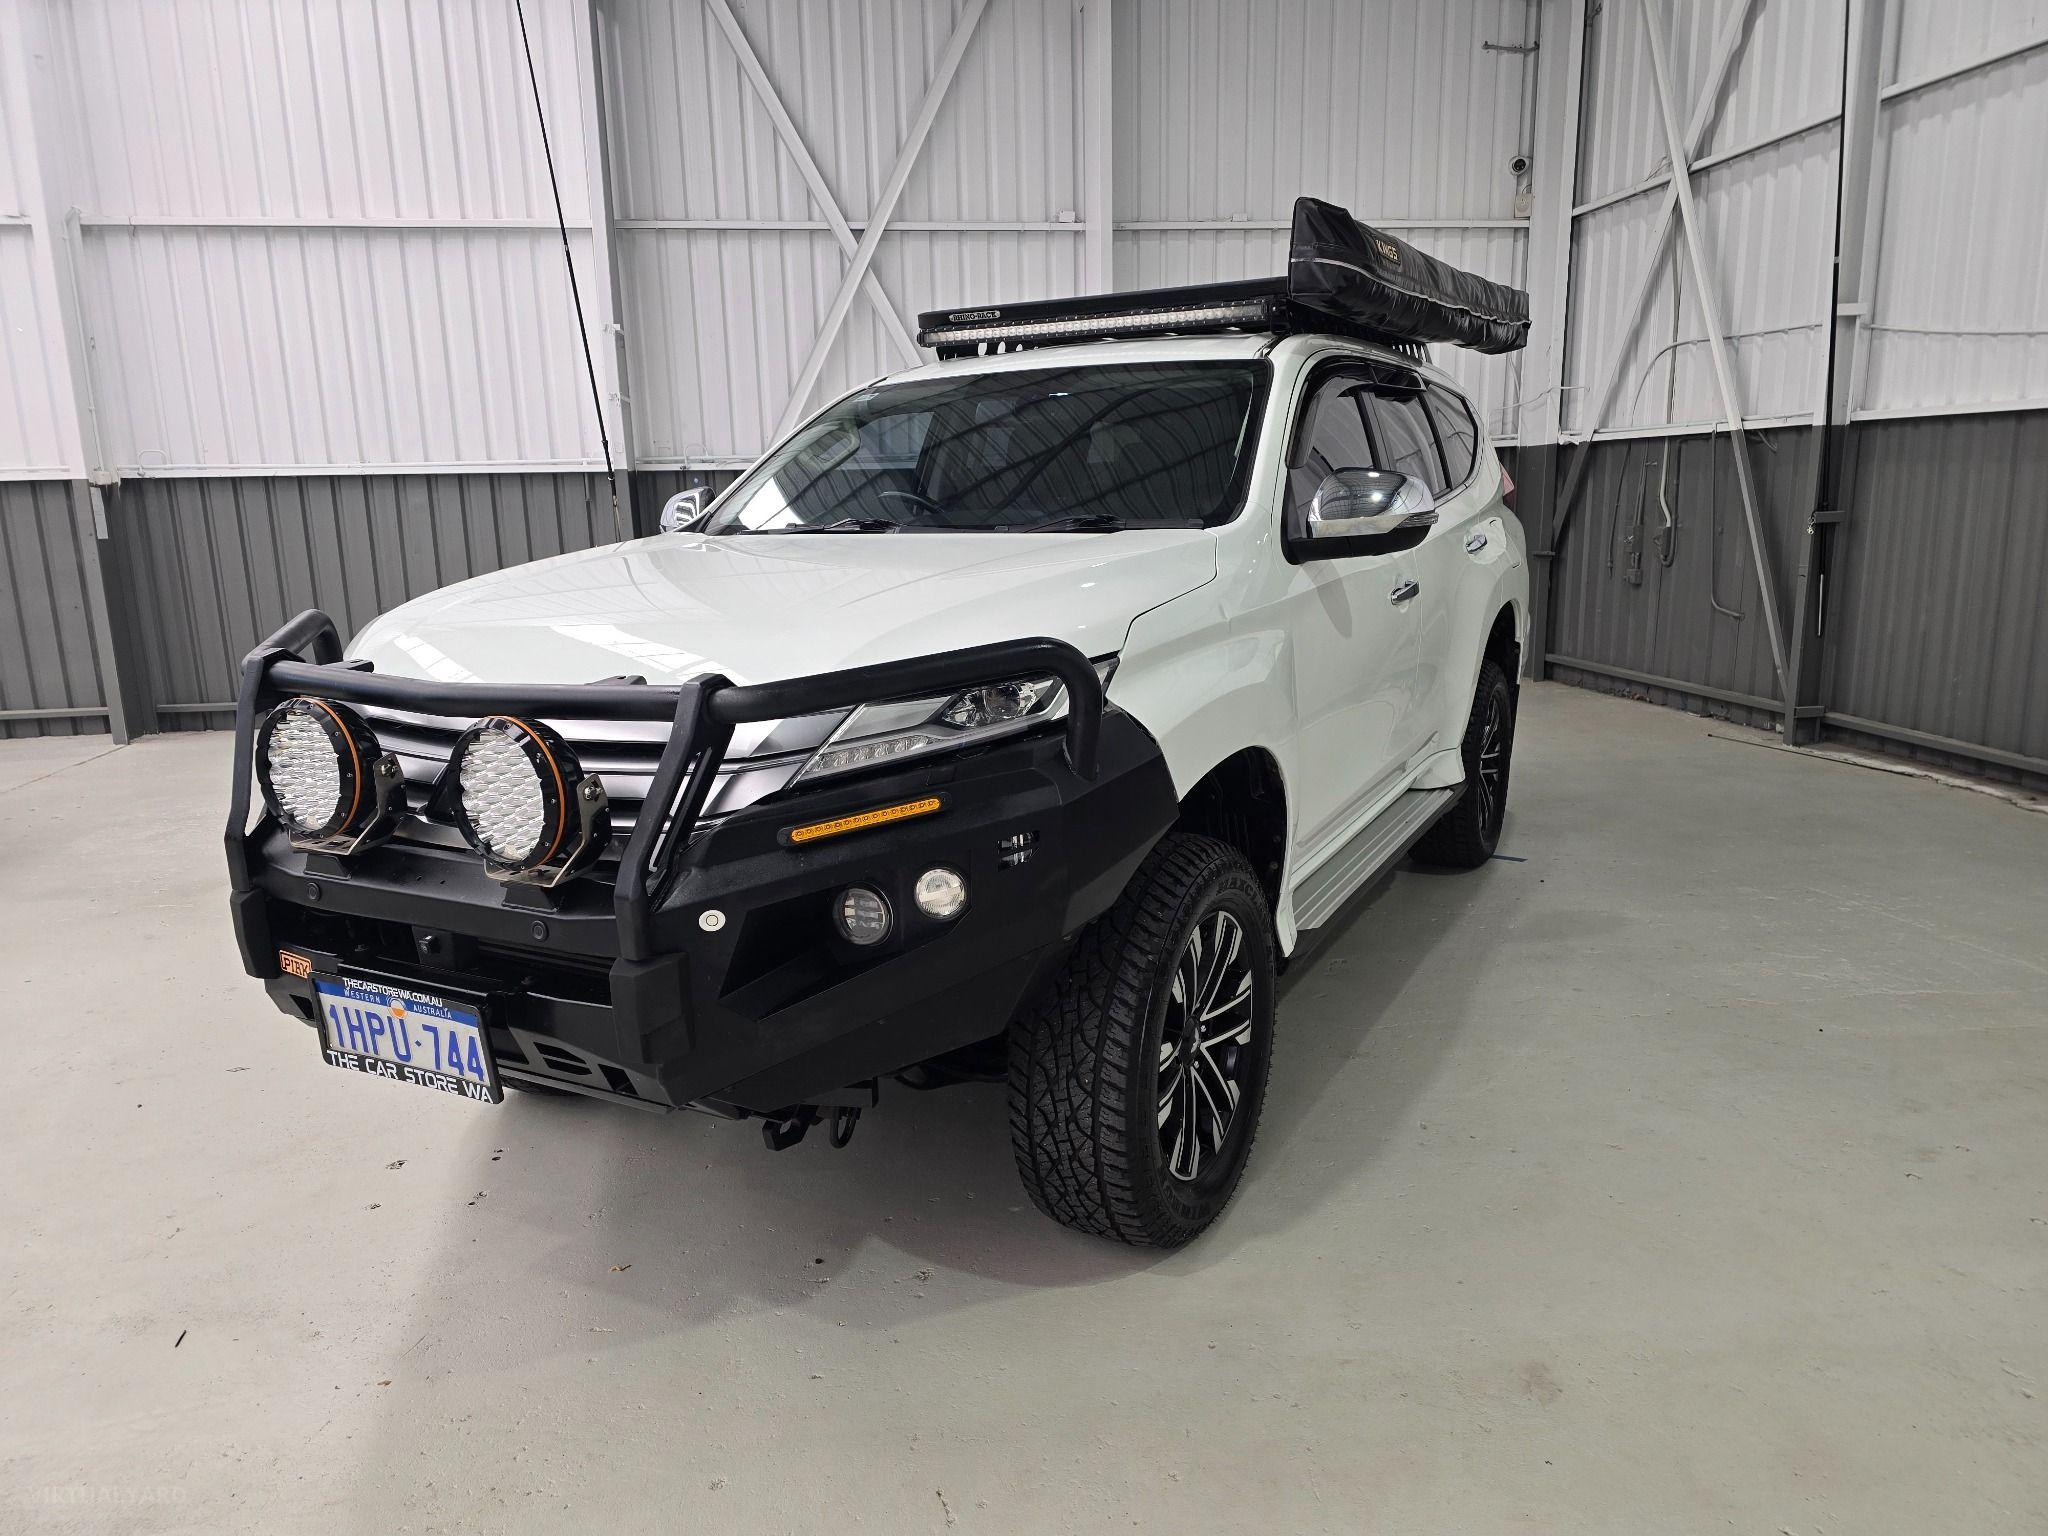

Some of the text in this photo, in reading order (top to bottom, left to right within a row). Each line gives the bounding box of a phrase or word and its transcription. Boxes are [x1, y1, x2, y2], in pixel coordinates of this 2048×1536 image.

[952, 311, 997, 320] RHINO-RACK
[343, 988, 453, 1019] WESTERN AUSTRALIA
[327, 1050, 494, 1104] THE CAR STORE WA
